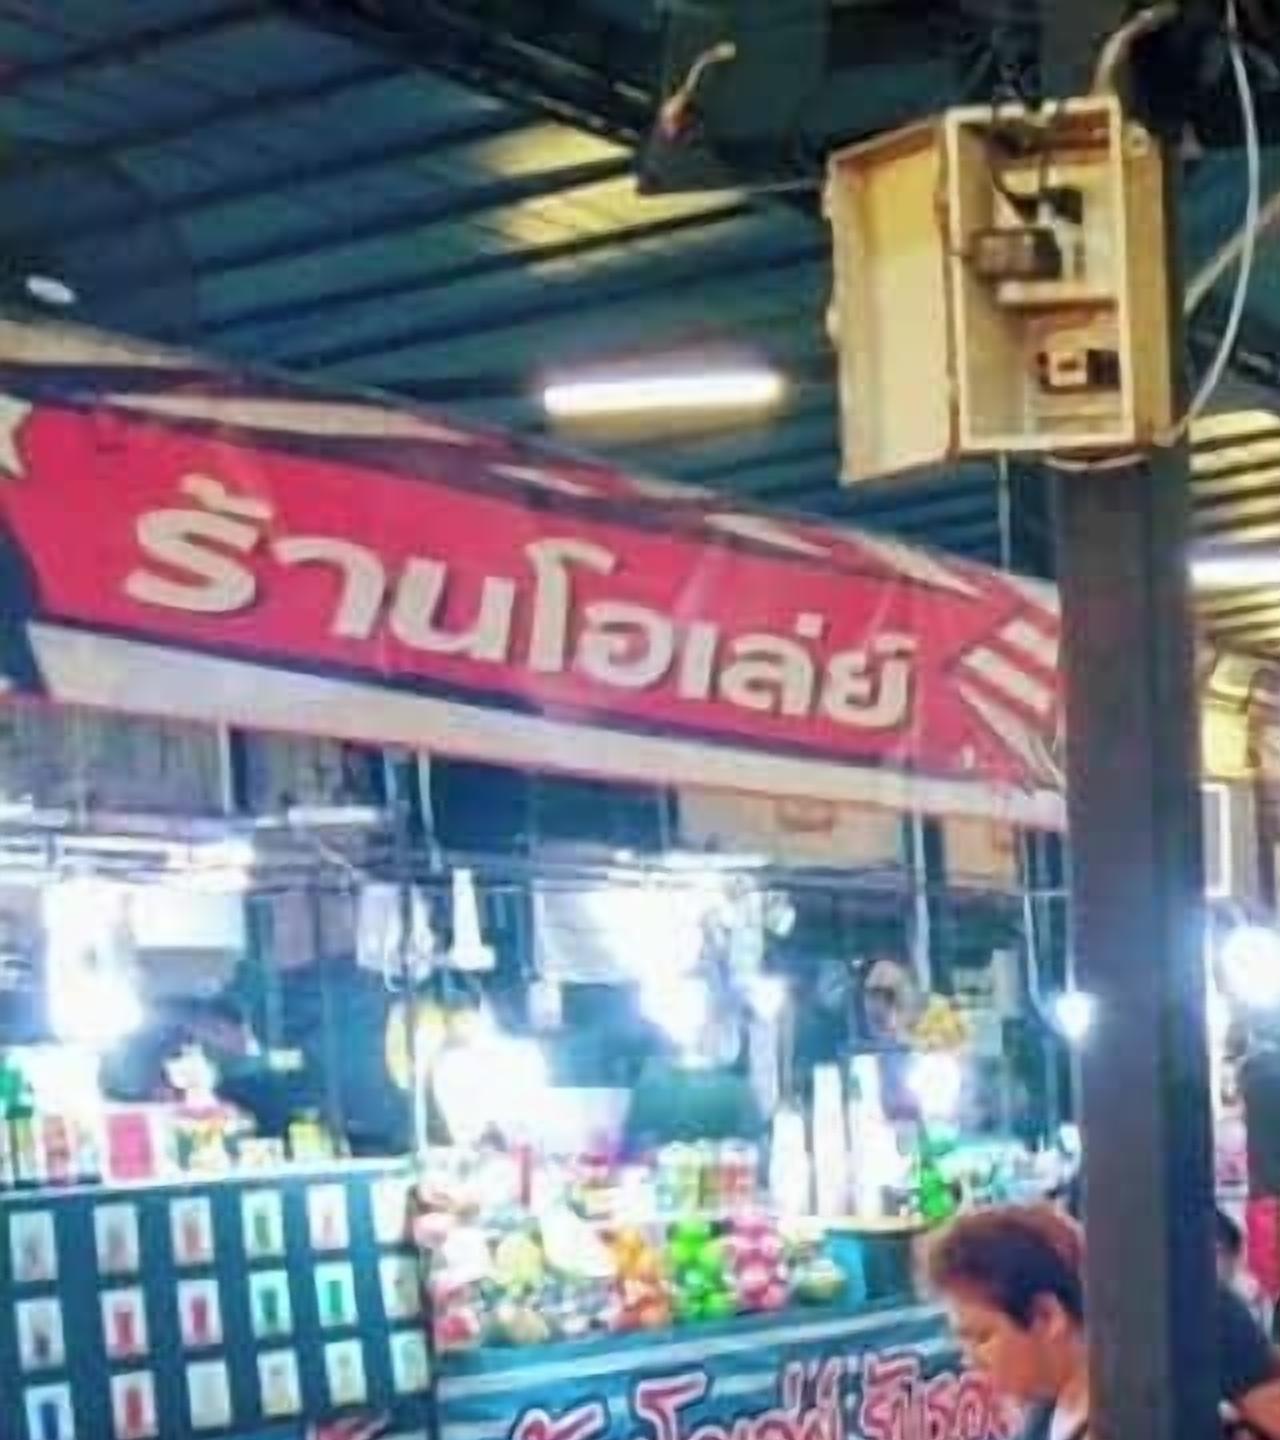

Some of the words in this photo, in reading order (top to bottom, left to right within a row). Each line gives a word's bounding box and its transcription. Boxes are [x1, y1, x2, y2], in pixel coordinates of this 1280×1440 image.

[125, 471, 918, 728] ร้านโอเล่ย์
